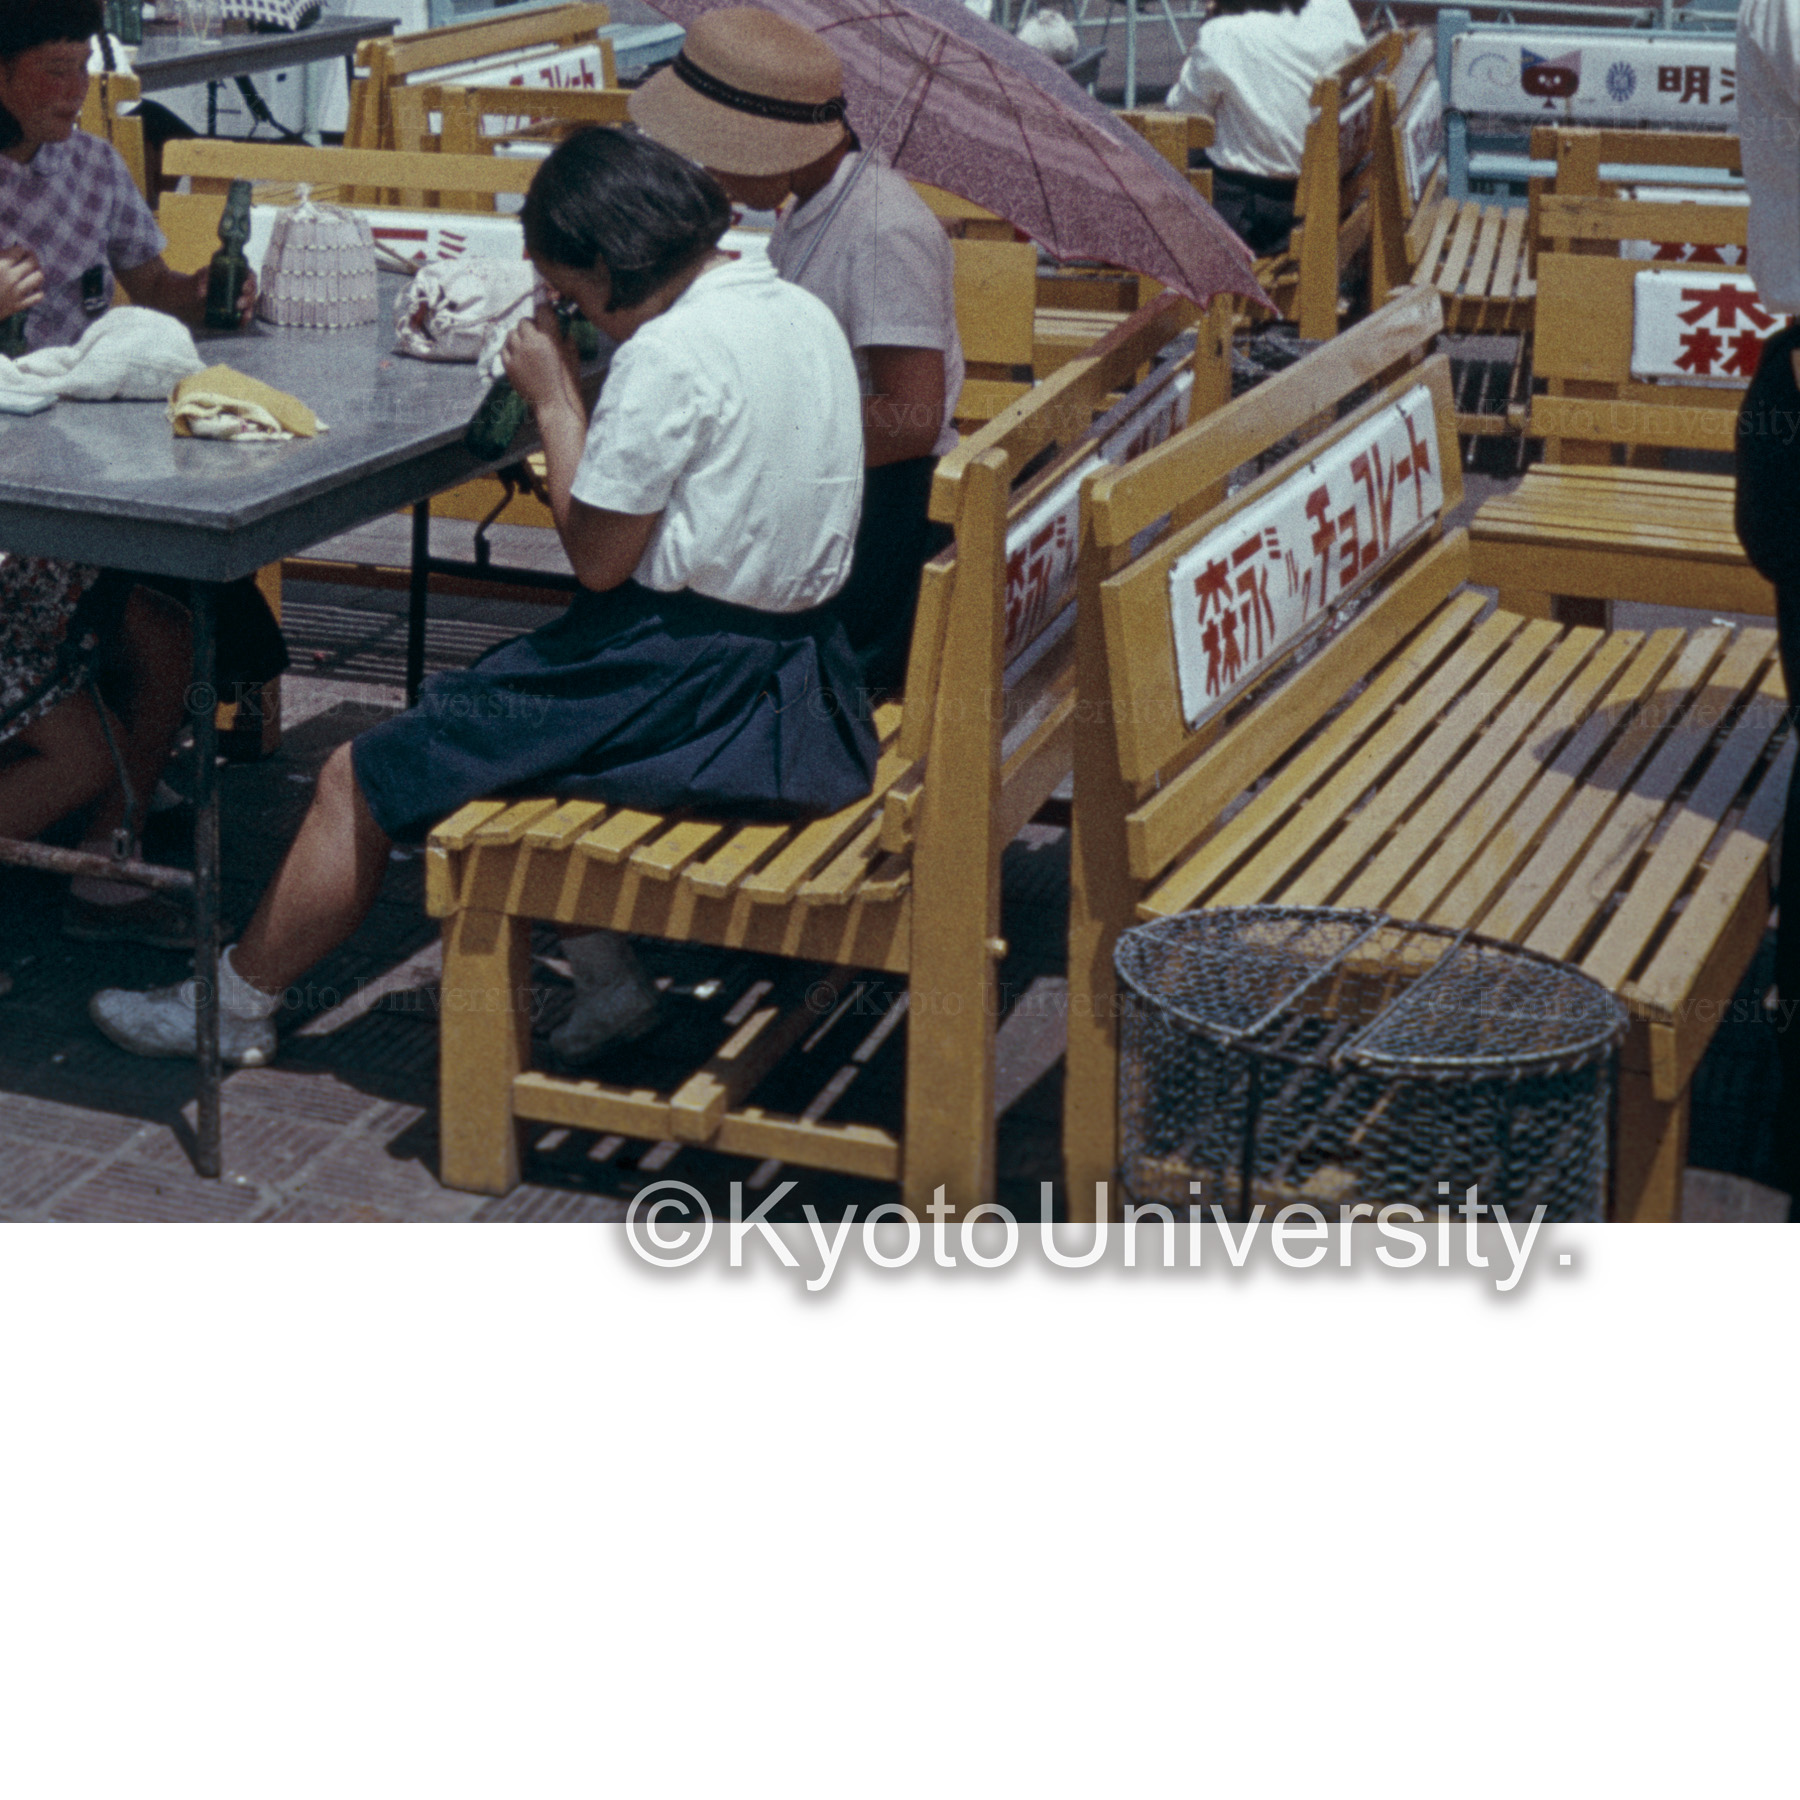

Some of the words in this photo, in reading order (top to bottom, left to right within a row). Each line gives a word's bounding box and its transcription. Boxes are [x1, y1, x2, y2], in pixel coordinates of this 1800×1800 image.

[1192, 416, 1430, 698] 森永ミルクチョコレート
